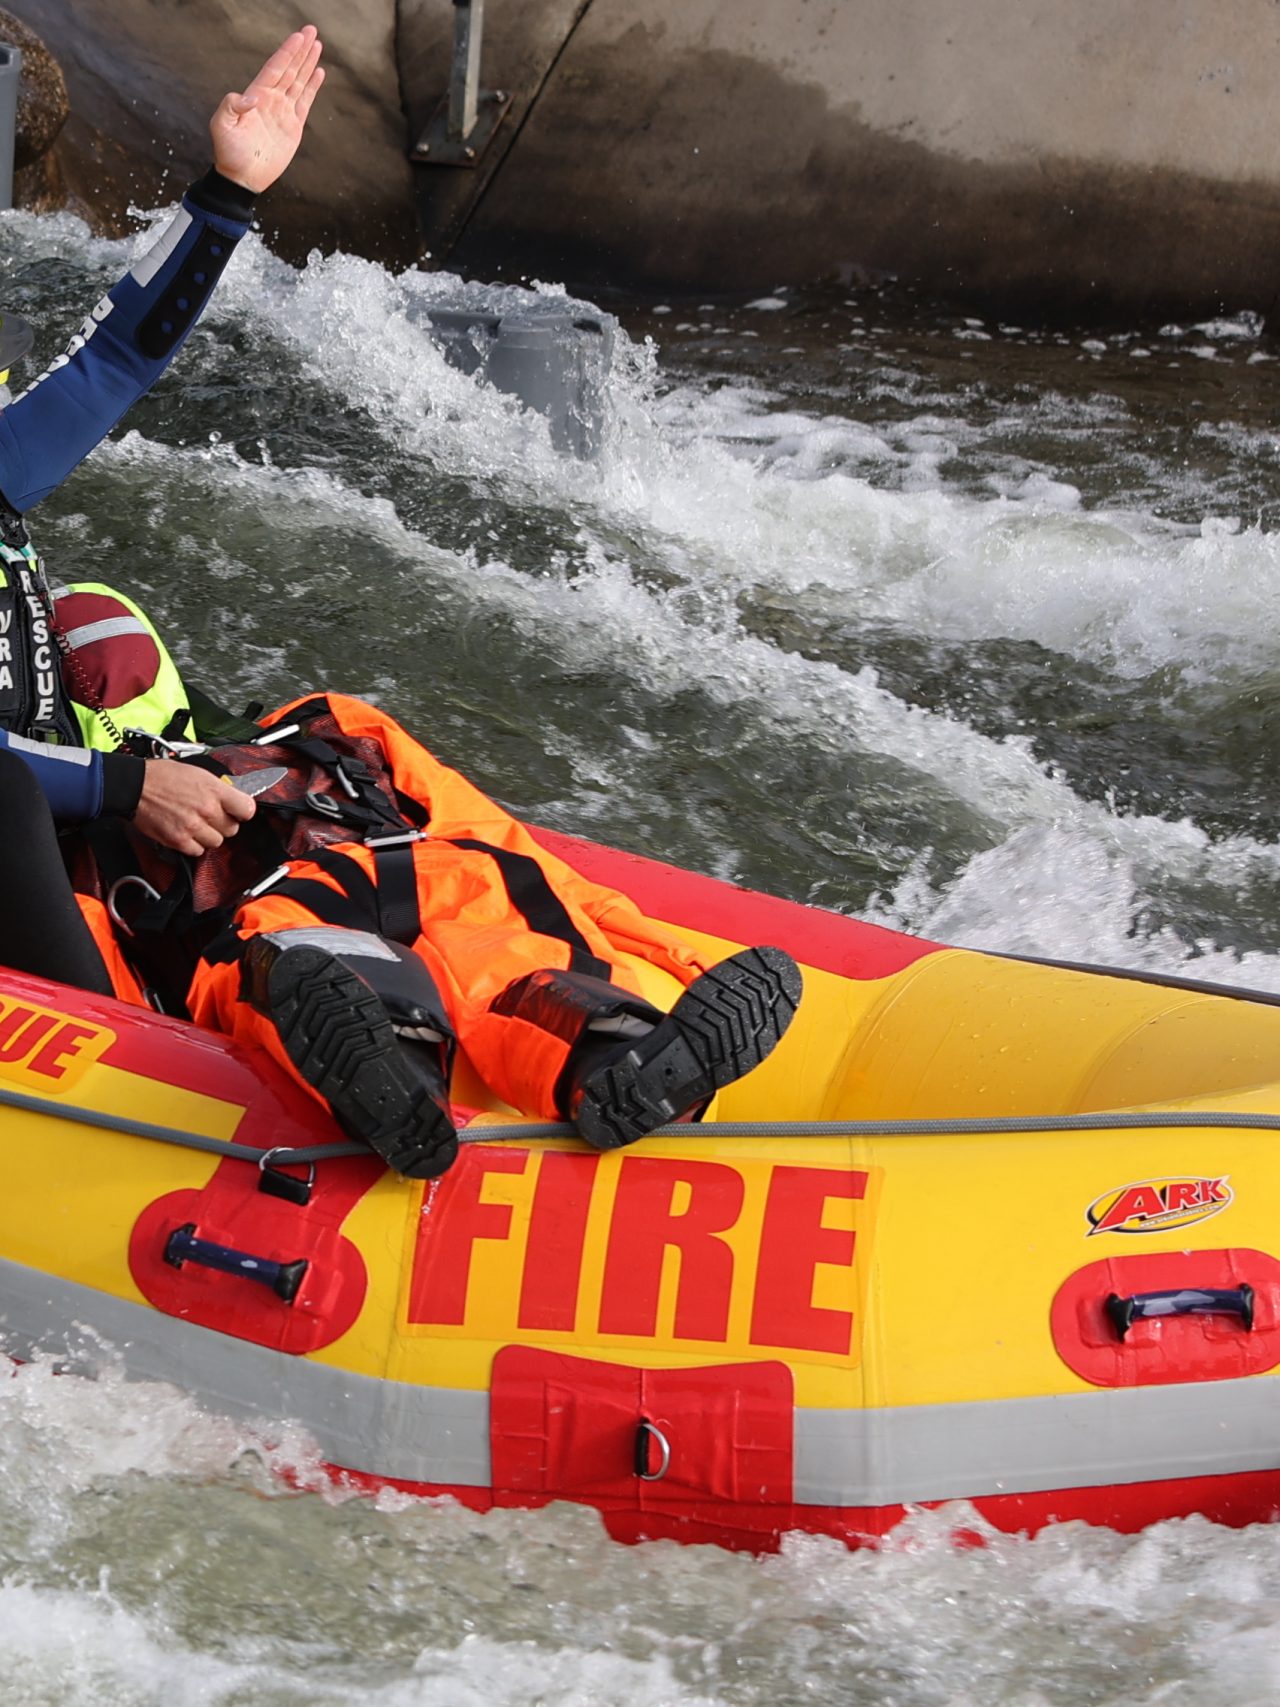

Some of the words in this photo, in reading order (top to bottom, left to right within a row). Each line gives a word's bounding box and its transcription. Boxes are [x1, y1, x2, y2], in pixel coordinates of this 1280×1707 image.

[19, 570, 55, 722] RESCUE
[406, 1143, 870, 1356] FIRE
[1094, 1178, 1227, 1231] ARK
